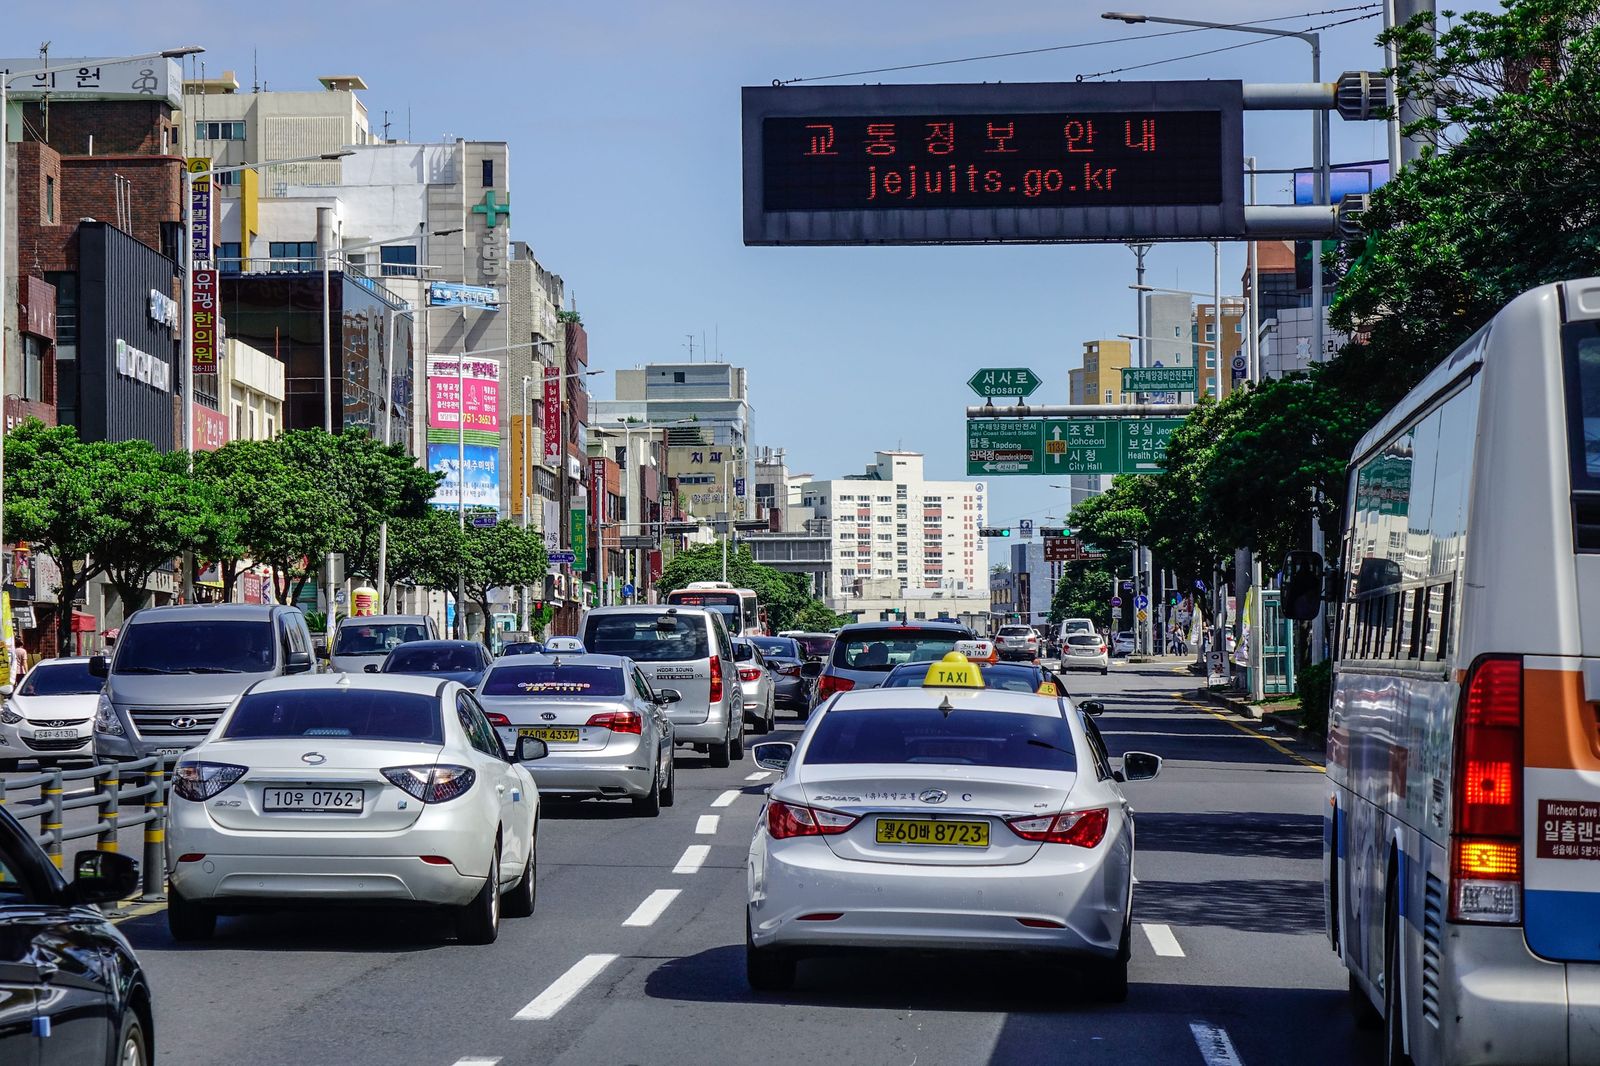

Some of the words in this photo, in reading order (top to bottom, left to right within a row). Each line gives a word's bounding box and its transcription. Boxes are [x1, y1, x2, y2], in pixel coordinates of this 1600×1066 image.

[1063, 119, 1156, 153] 안내
[866, 162, 1117, 199] jejuits.go.kr
[982, 371, 1028, 385] 서사로
[1133, 370, 1193, 381] 제주해양경비안전본부
[984, 385, 1023, 395] Seosaro
[1069, 424, 1095, 436] 조천
[1128, 423, 1154, 436] 정실
[969, 438, 991, 449] 탑동
[991, 441, 1022, 450] Tapdong
[1128, 439, 1167, 450] 보건소
[691, 452, 723, 463] 치과
[1069, 449, 1097, 462] 시청
[1127, 451, 1151, 460] Health
[1068, 462, 1085, 471] City
[1087, 462, 1103, 471] Hall
[938, 671, 968, 683] TAXI
[542, 712, 555, 720] KIA
[55, 729, 74, 738] 6130
[549, 729, 575, 740] 4337
[274, 791, 304, 807] 10우
[312, 791, 354, 807] 0762
[962, 793, 972, 801] C
[1546, 804, 1578, 816] Micheon
[1579, 805, 1598, 818] Cave
[884, 822, 930, 840] 제주60바
[935, 823, 982, 843] 8723
[1552, 844, 1579, 856] 성읍에서
[1581, 845, 1600, 857] 5분거
